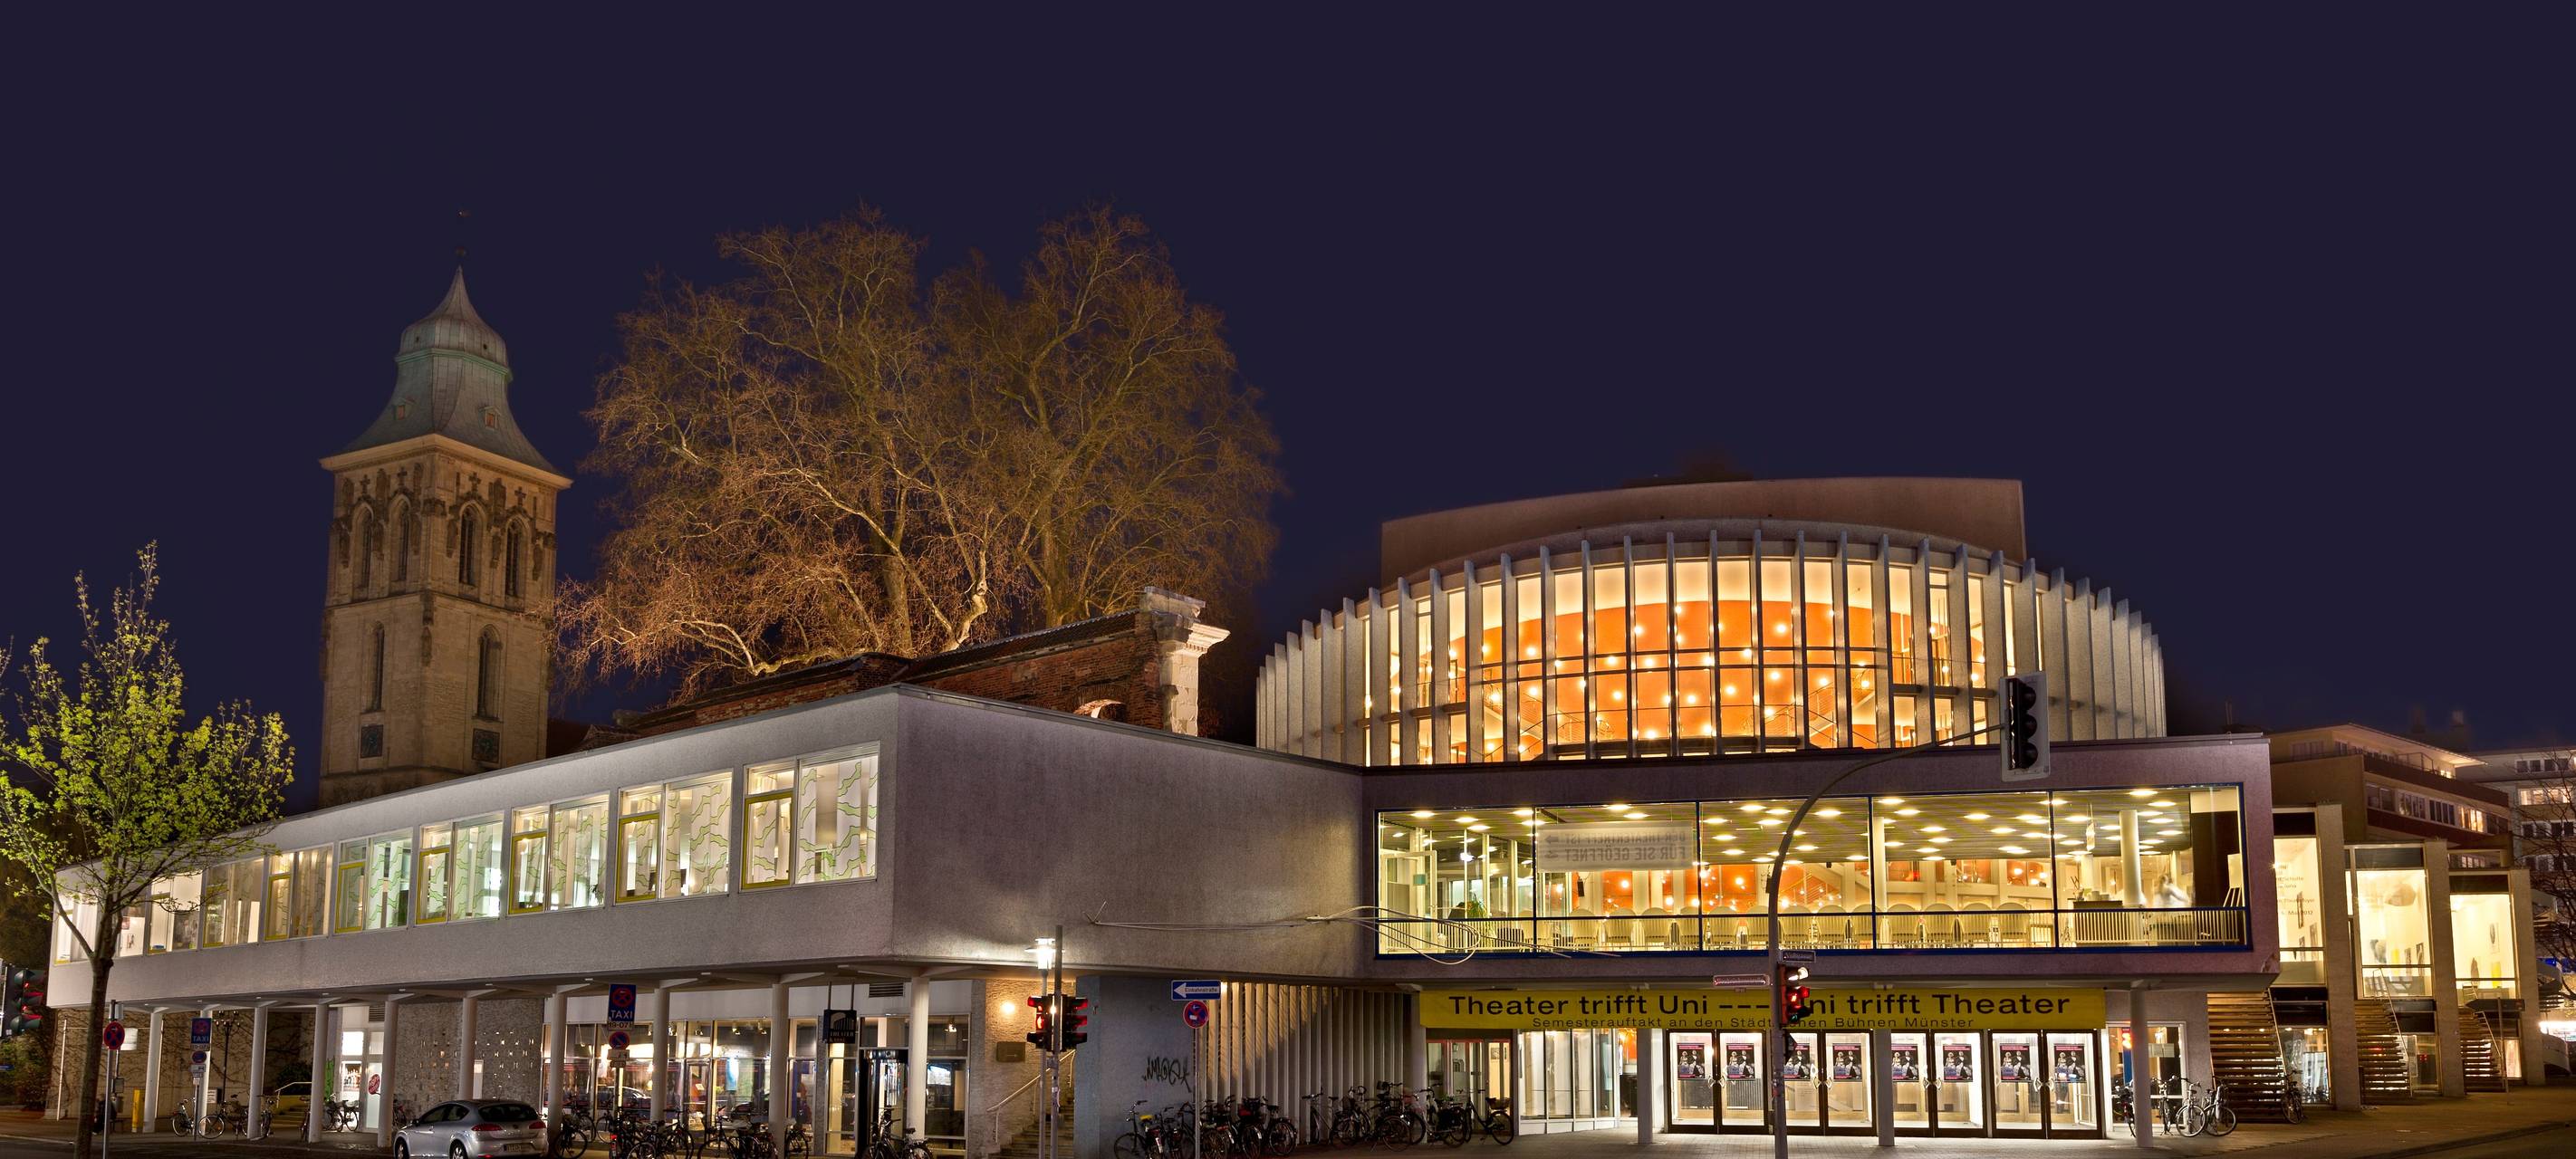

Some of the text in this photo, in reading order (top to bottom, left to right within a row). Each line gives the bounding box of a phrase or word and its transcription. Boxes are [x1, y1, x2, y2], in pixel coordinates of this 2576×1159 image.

[1448, 996, 1569, 1015] Theater
[1579, 994, 1648, 1015] trifft
[1659, 994, 1708, 1015] Uni
[1847, 993, 1921, 1015] trifft
[1932, 994, 2071, 1014] Theater
[610, 1010, 632, 1020] TAXI
[1533, 1017, 1662, 1029] Semesterauftakt
[1668, 1019, 1687, 1029] an
[1695, 1017, 1723, 1028] den
[1835, 1017, 1897, 1029] Bühnen
[1905, 1017, 1975, 1029] Münster
